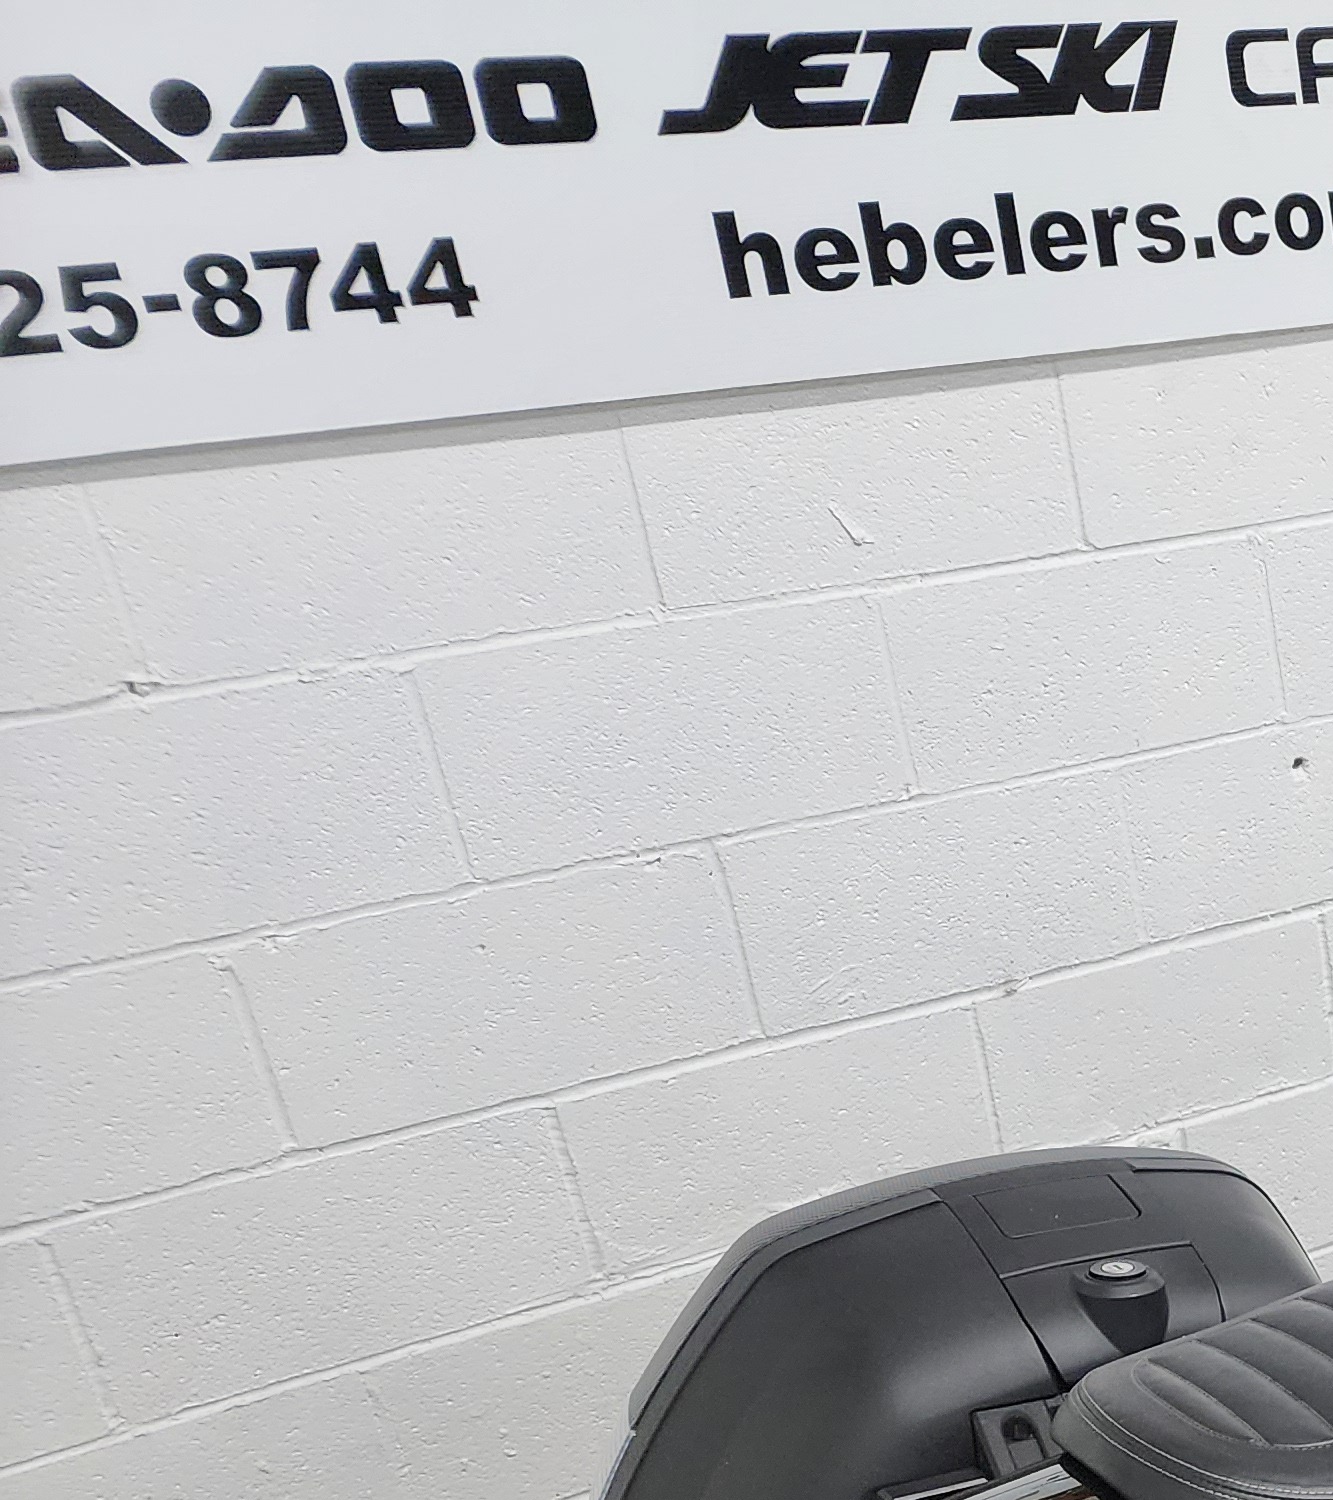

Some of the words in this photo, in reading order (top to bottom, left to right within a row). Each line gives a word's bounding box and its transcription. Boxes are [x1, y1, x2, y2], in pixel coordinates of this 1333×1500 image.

[657, 26, 973, 136] JET
[949, 19, 1179, 122] SKI
[0, 237, 480, 358] 25-8744
